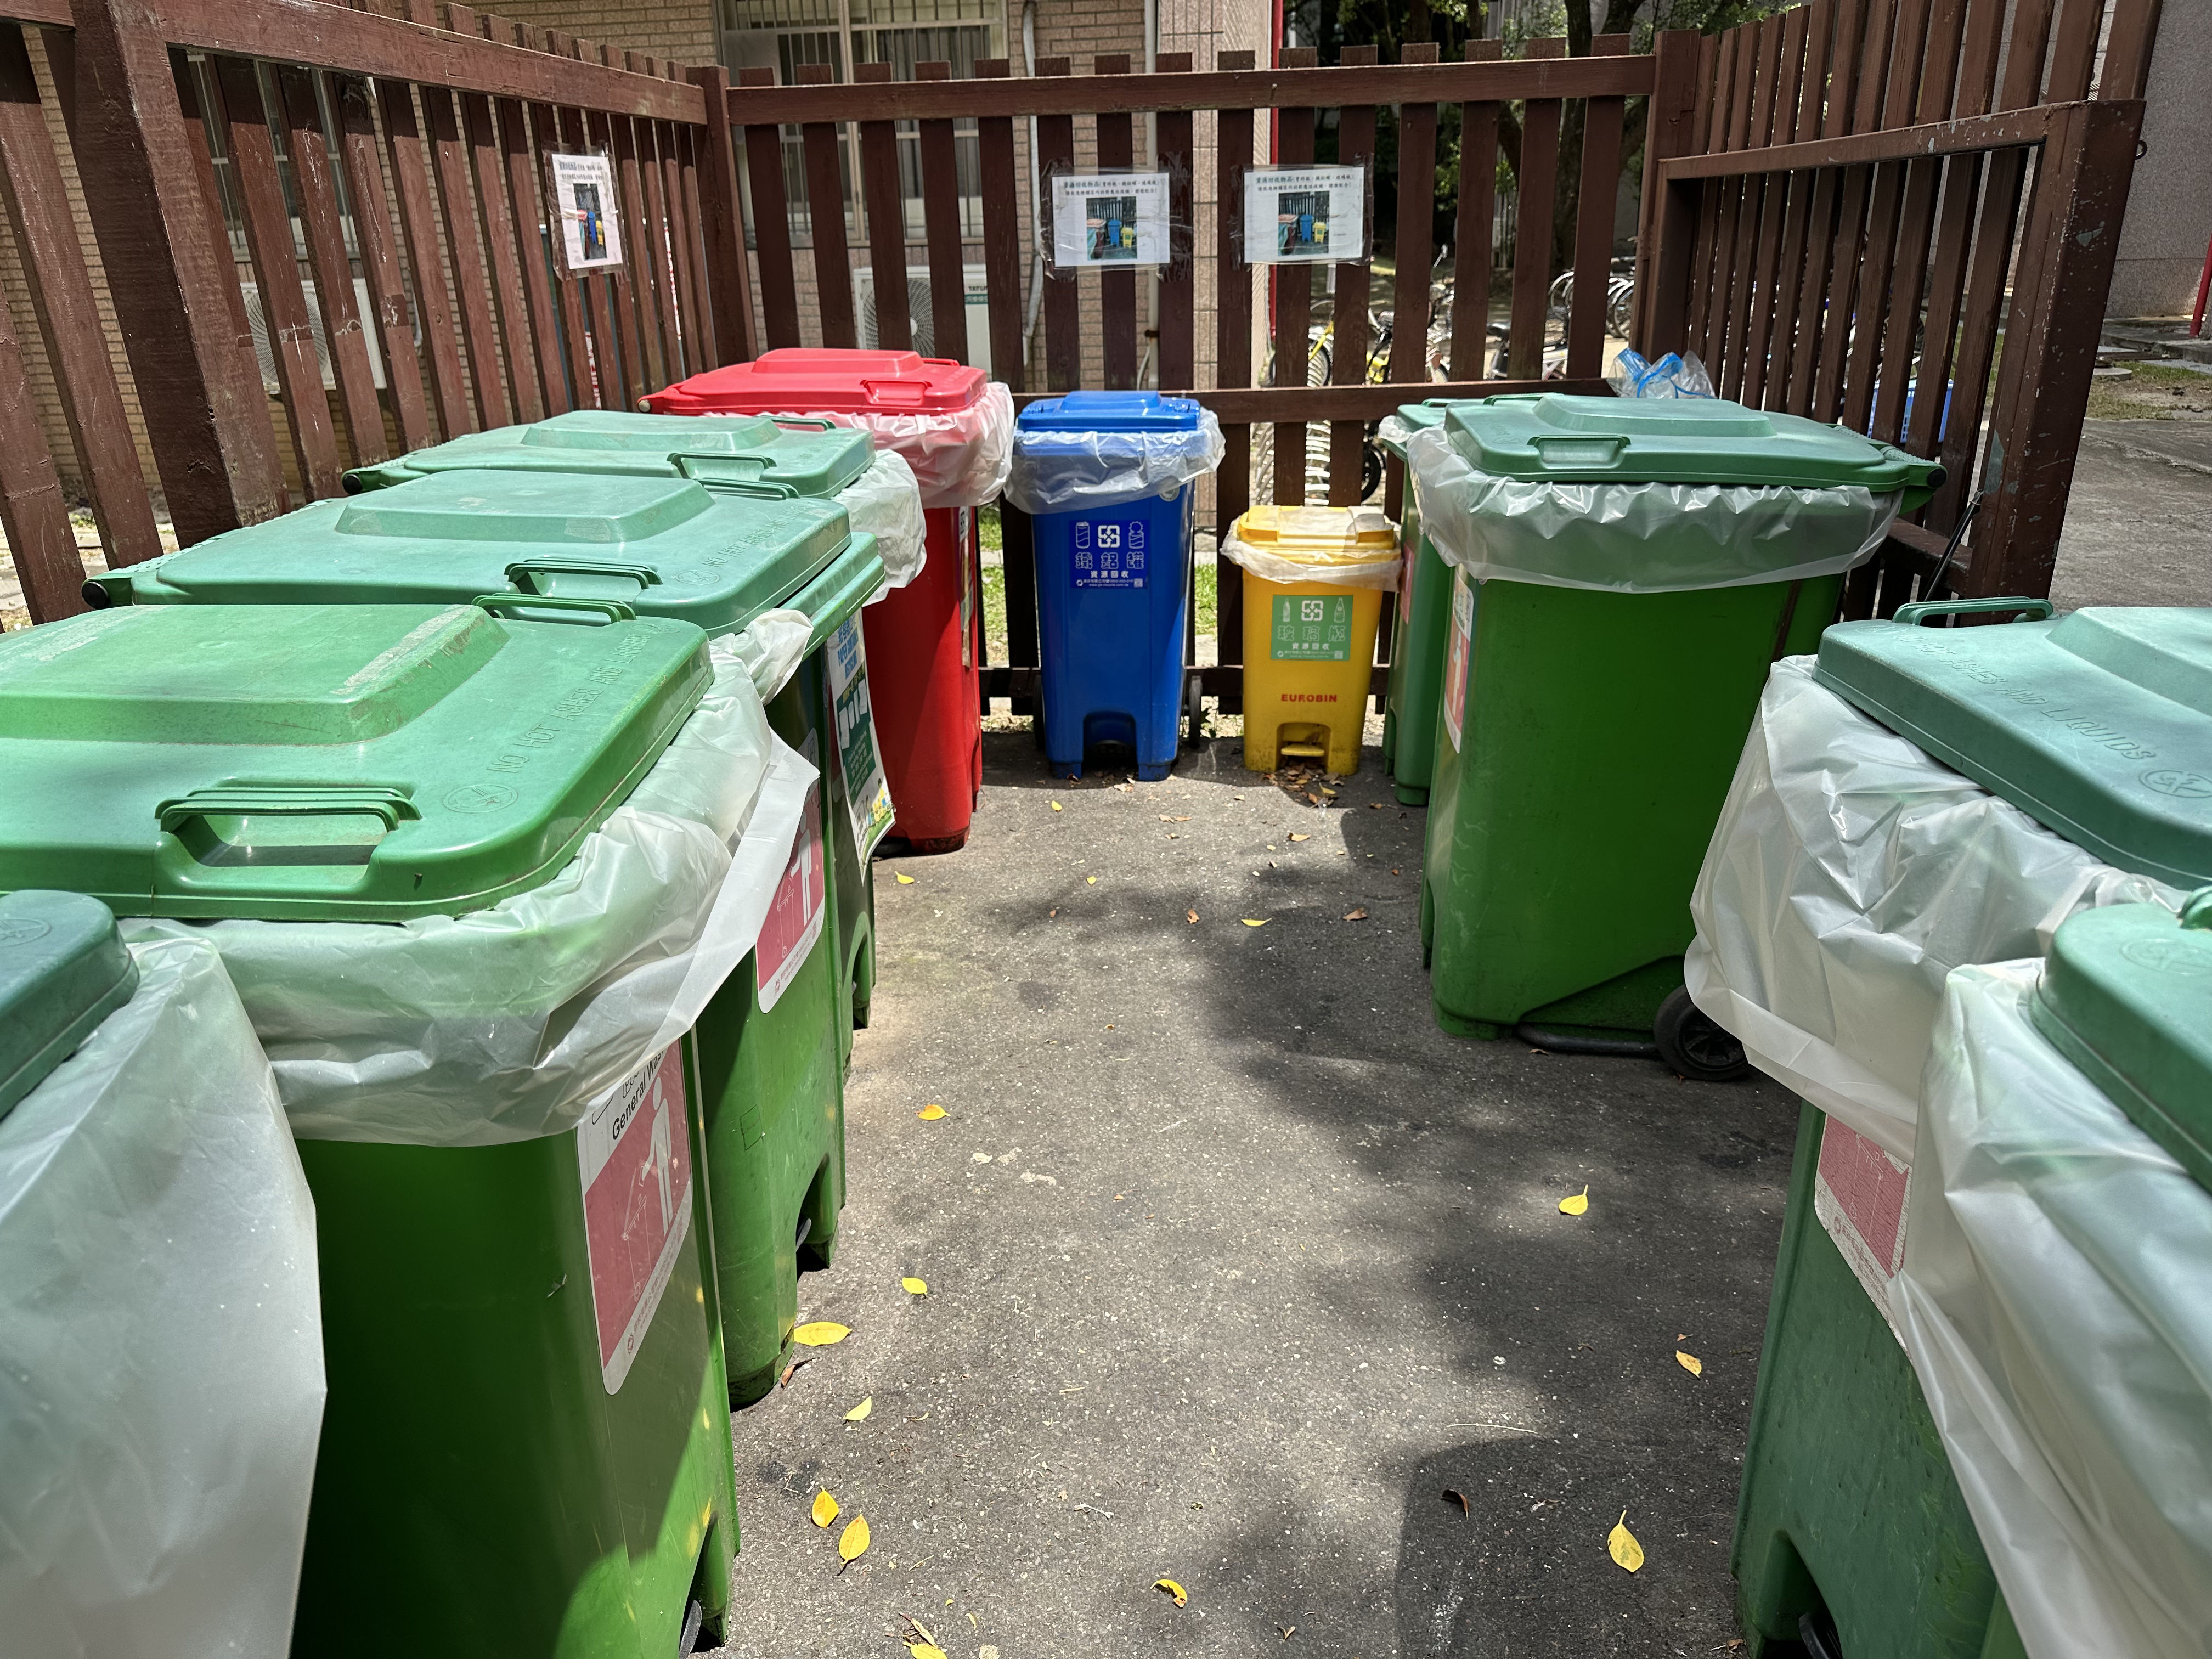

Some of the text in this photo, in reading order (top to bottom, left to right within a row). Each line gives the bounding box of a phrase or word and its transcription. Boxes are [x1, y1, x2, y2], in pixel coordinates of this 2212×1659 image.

[1075, 551, 1144, 569] 鐵鋁罐
[487, 633, 652, 774] NO HOT ASHES AND LIQUIDS
[1281, 693, 1338, 703] EUROBIN
[1911, 642, 1957, 656] HOT
[1939, 658, 2008, 685] ASHES
[1995, 688, 2049, 706] AND
[2040, 708, 2157, 760] LIQUIDS
[612, 1071, 646, 1140] General
[647, 1051, 664, 1081] Was
